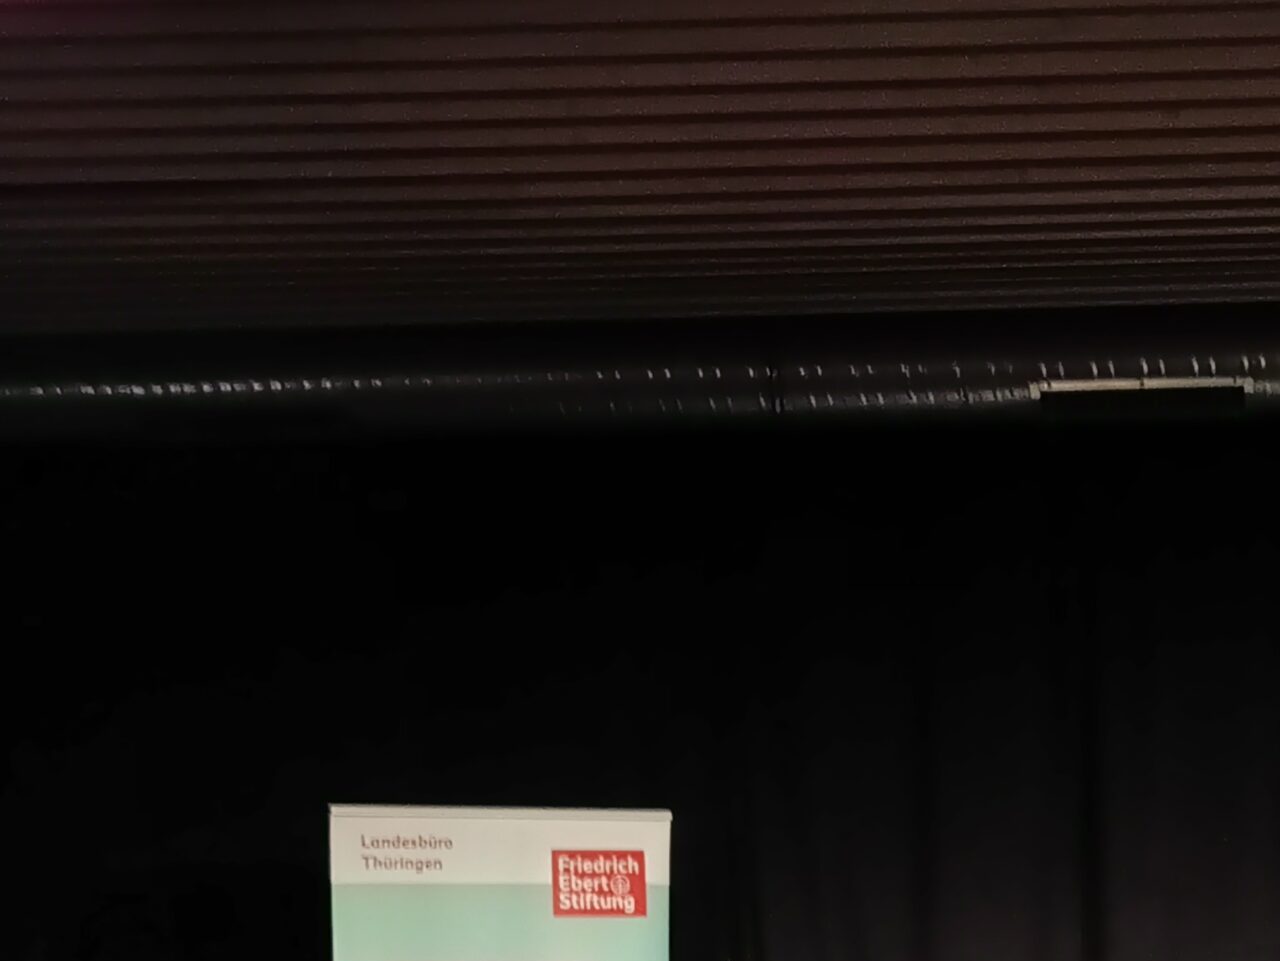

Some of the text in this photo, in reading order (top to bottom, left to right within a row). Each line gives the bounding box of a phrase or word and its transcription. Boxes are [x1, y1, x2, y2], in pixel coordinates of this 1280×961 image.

[360, 833, 453, 850] Landesbüro
[361, 855, 443, 875] Thüringen
[558, 854, 639, 875] Friedrich
[559, 874, 609, 893] Ebert
[559, 892, 635, 914] Stiftung
